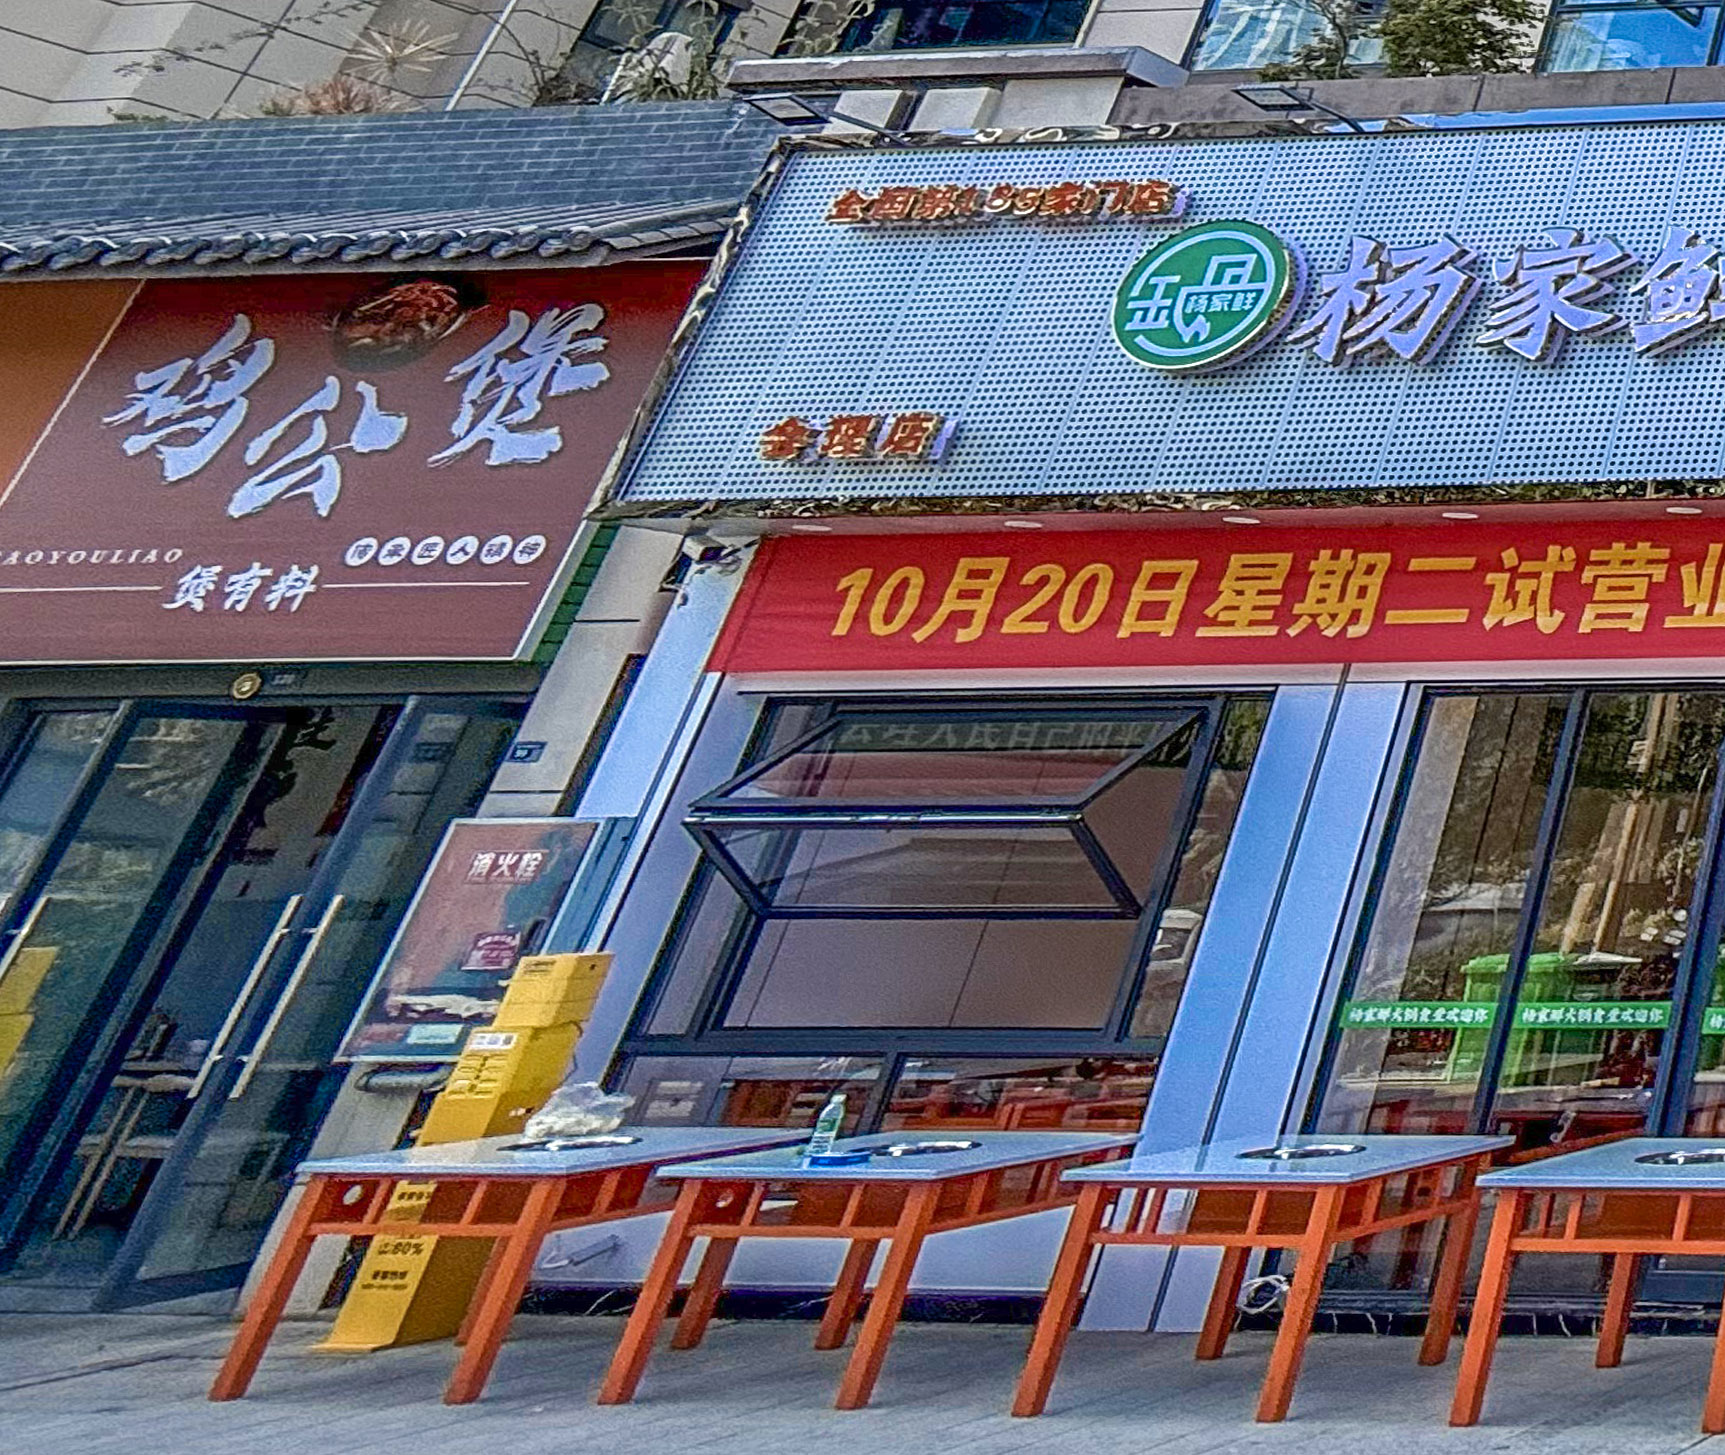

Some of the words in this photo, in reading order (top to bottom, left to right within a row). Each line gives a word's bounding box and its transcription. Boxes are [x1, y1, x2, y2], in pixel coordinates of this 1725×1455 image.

[1185, 292, 1256, 313] 杨家鲜
[102, 302, 611, 520] 鸡公煲
[162, 562, 319, 614] 煲有料
